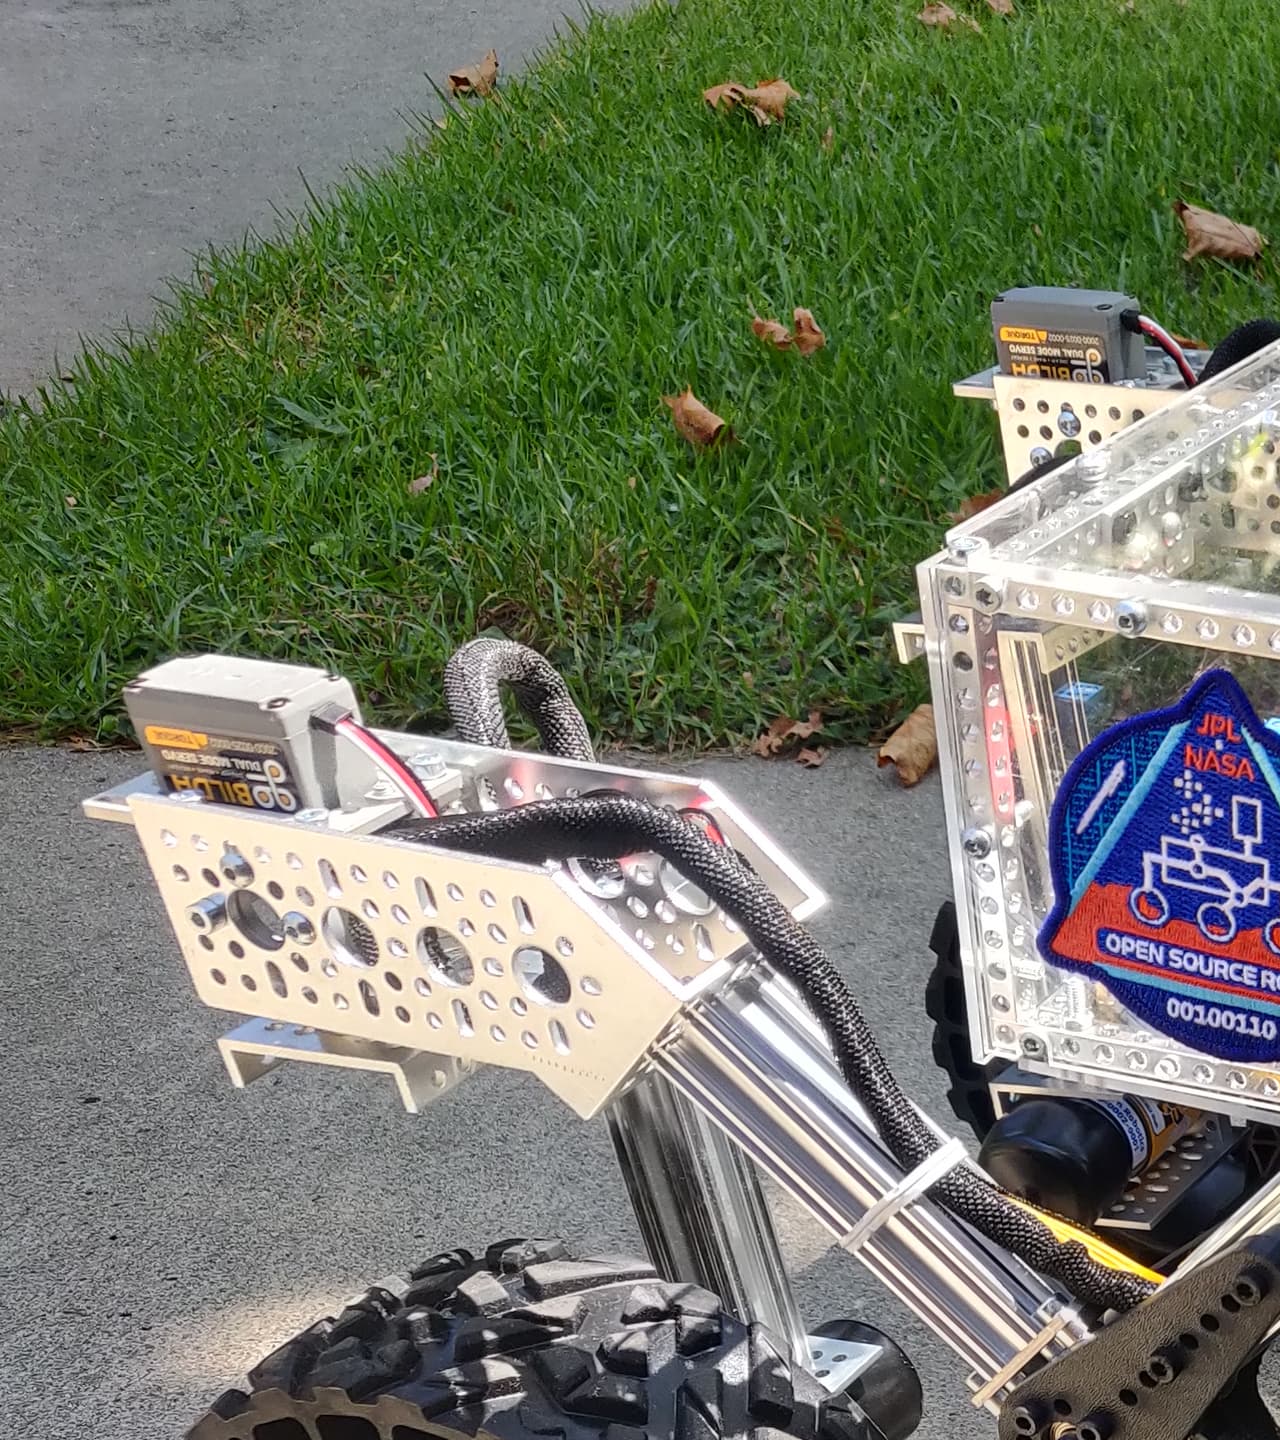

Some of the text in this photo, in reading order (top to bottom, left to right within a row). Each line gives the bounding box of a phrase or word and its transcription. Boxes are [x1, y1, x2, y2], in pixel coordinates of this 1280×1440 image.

[1006, 331, 1034, 341] TORQUE
[1009, 344, 1084, 359] DUAL MODE SERVO
[1197, 713, 1241, 743] JPL
[160, 749, 197, 764] SERVO
[197, 754, 230, 769] MODE
[230, 758, 261, 772] DUAL
[1184, 744, 1254, 781] NASA
[1105, 933, 1165, 965] OPEN
[1168, 948, 1258, 986] SOURCE
[1166, 997, 1277, 1040] 00100110
[1123, 1107, 1144, 1152] Robotics
